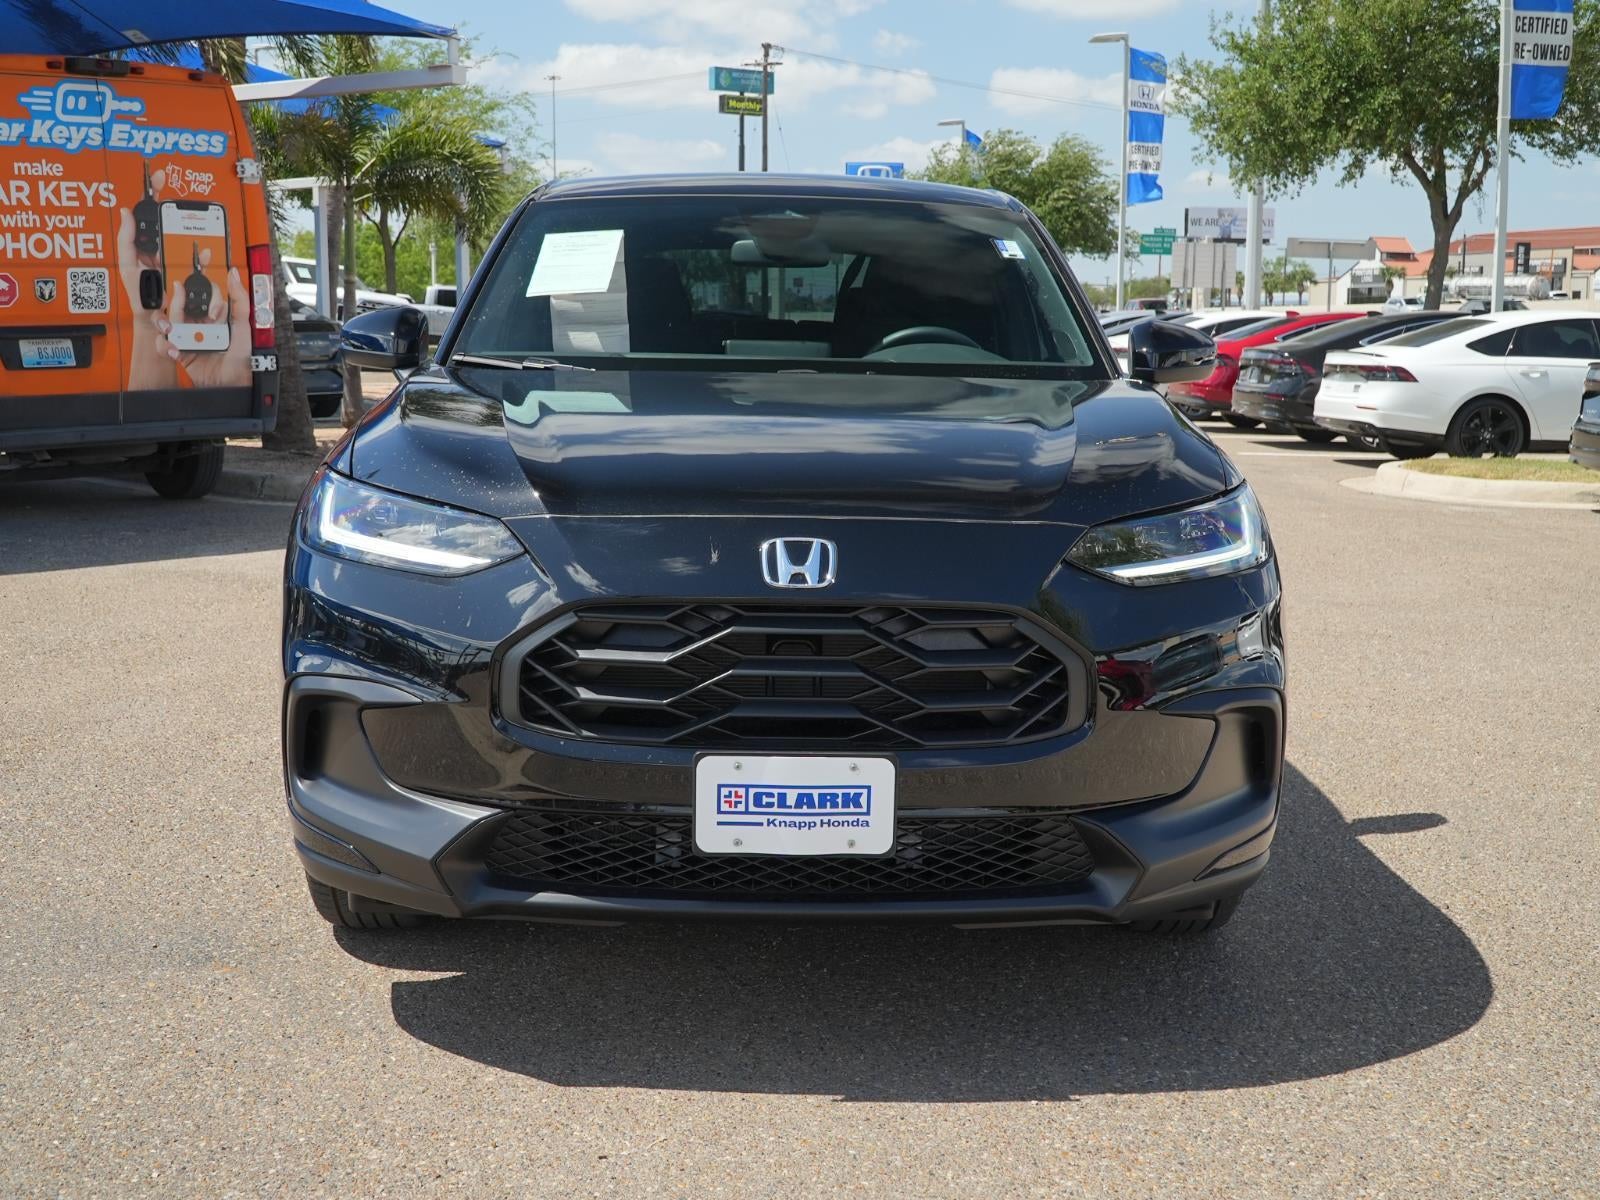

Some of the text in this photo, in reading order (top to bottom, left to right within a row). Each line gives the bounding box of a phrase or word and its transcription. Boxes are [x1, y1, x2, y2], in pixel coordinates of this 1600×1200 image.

[1515, 15, 1568, 35] CERTIFIED
[1130, 99, 1160, 111] HONDA
[30, 119, 103, 150] Keys
[108, 123, 225, 154] Express
[1130, 144, 1160, 157] CERTIFIED
[13, 158, 64, 177] make
[184, 169, 214, 185] Snap
[38, 180, 117, 208] KEYS
[0, 210, 86, 232] with your
[1190, 217, 1220, 227] WE ARE
[0, 232, 104, 260] HONE!
[752, 791, 864, 809] CLARK
[766, 818, 871, 831] Knapp Honda
